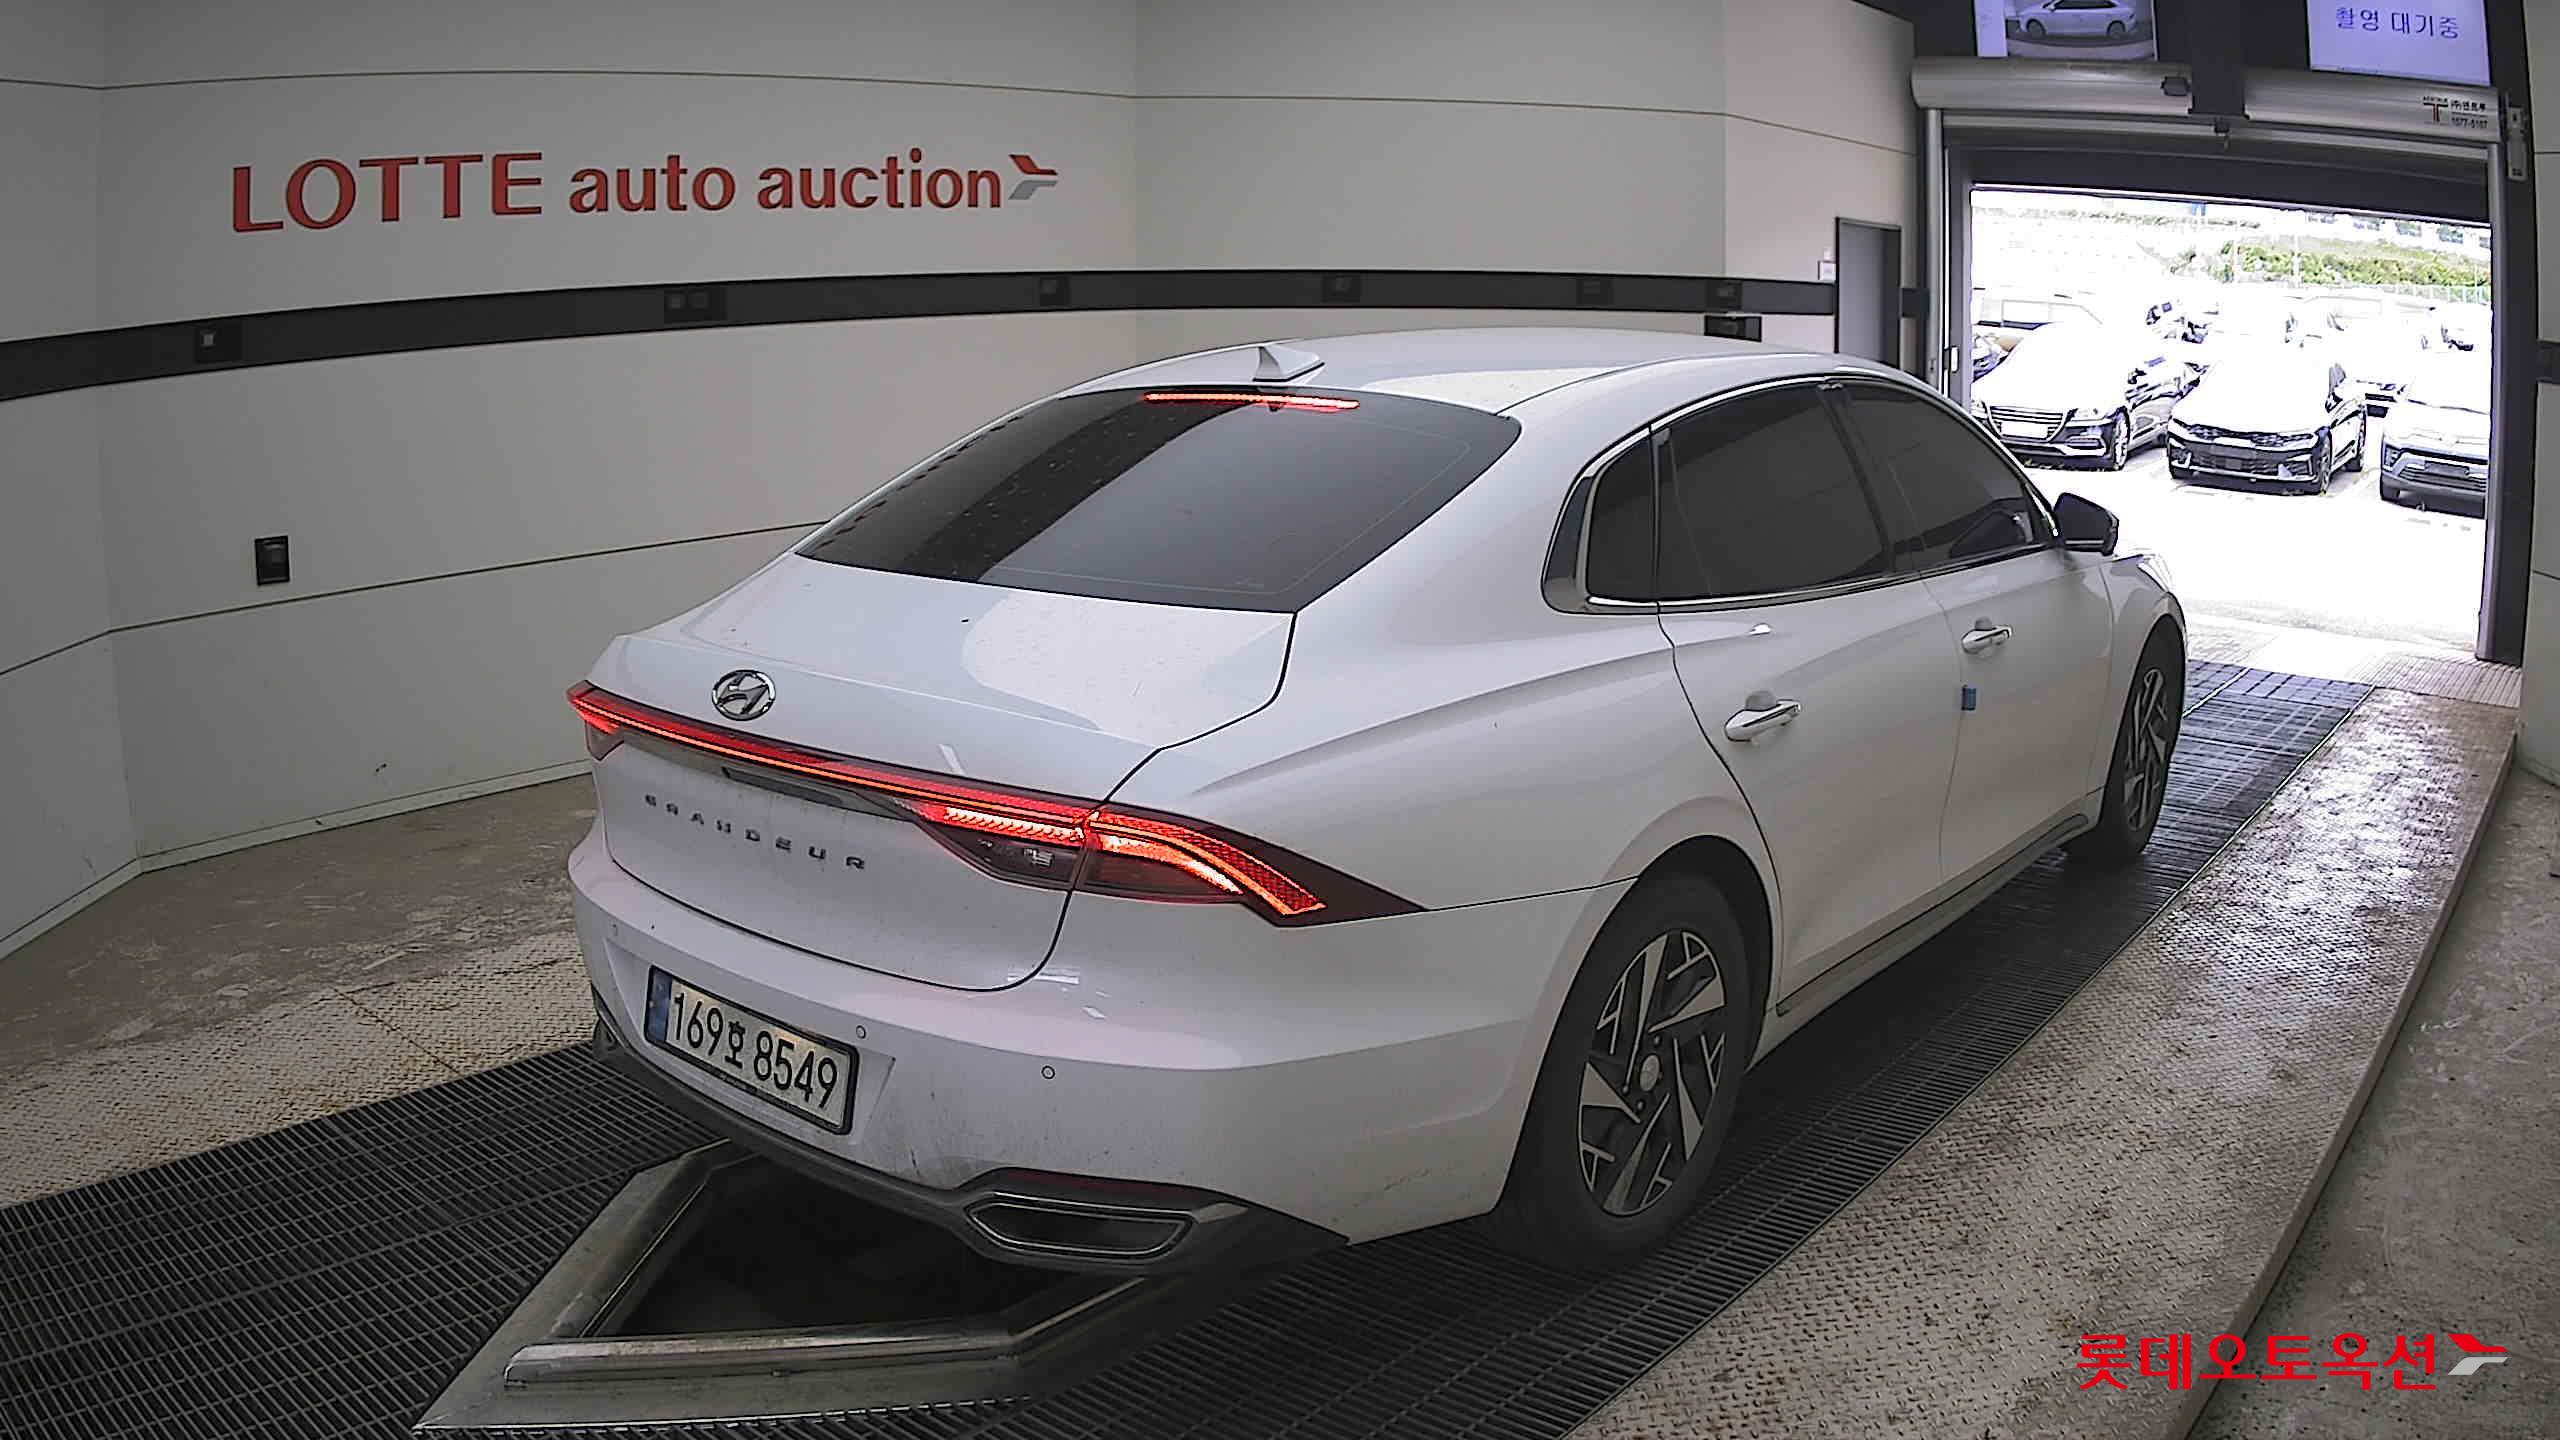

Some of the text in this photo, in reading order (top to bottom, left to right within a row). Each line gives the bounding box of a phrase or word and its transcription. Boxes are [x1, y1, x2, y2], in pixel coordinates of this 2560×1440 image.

[2336, 7, 2460, 39] 촬영 대기중
[232, 146, 1002, 233] LOTTE auto auction
[644, 794, 865, 870] GRANDEUR
[673, 992, 838, 1109] 169호 8549
